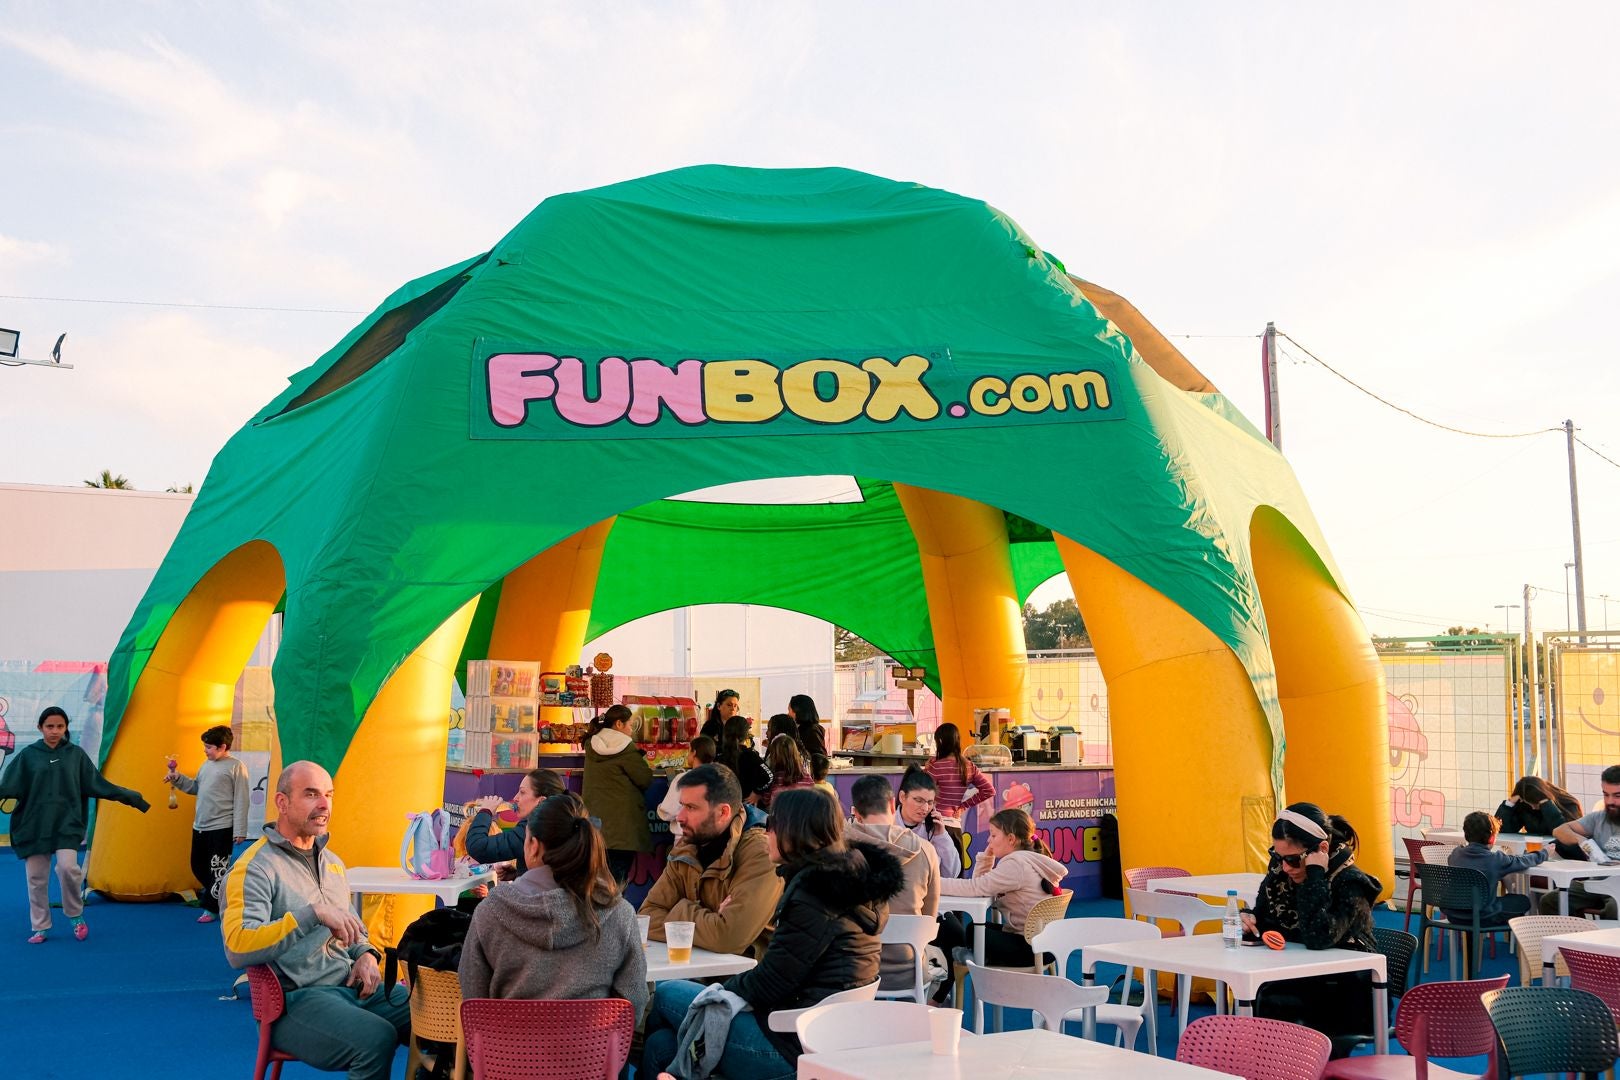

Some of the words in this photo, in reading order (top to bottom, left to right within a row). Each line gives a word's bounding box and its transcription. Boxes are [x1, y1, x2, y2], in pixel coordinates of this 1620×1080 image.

[1045, 800, 1054, 809] EL
[1055, 799, 1085, 808] PARQUE
[1040, 808, 1057, 820] MÁS
[1058, 809, 1090, 819] GRANDE
[1091, 808, 1104, 818] DEL
